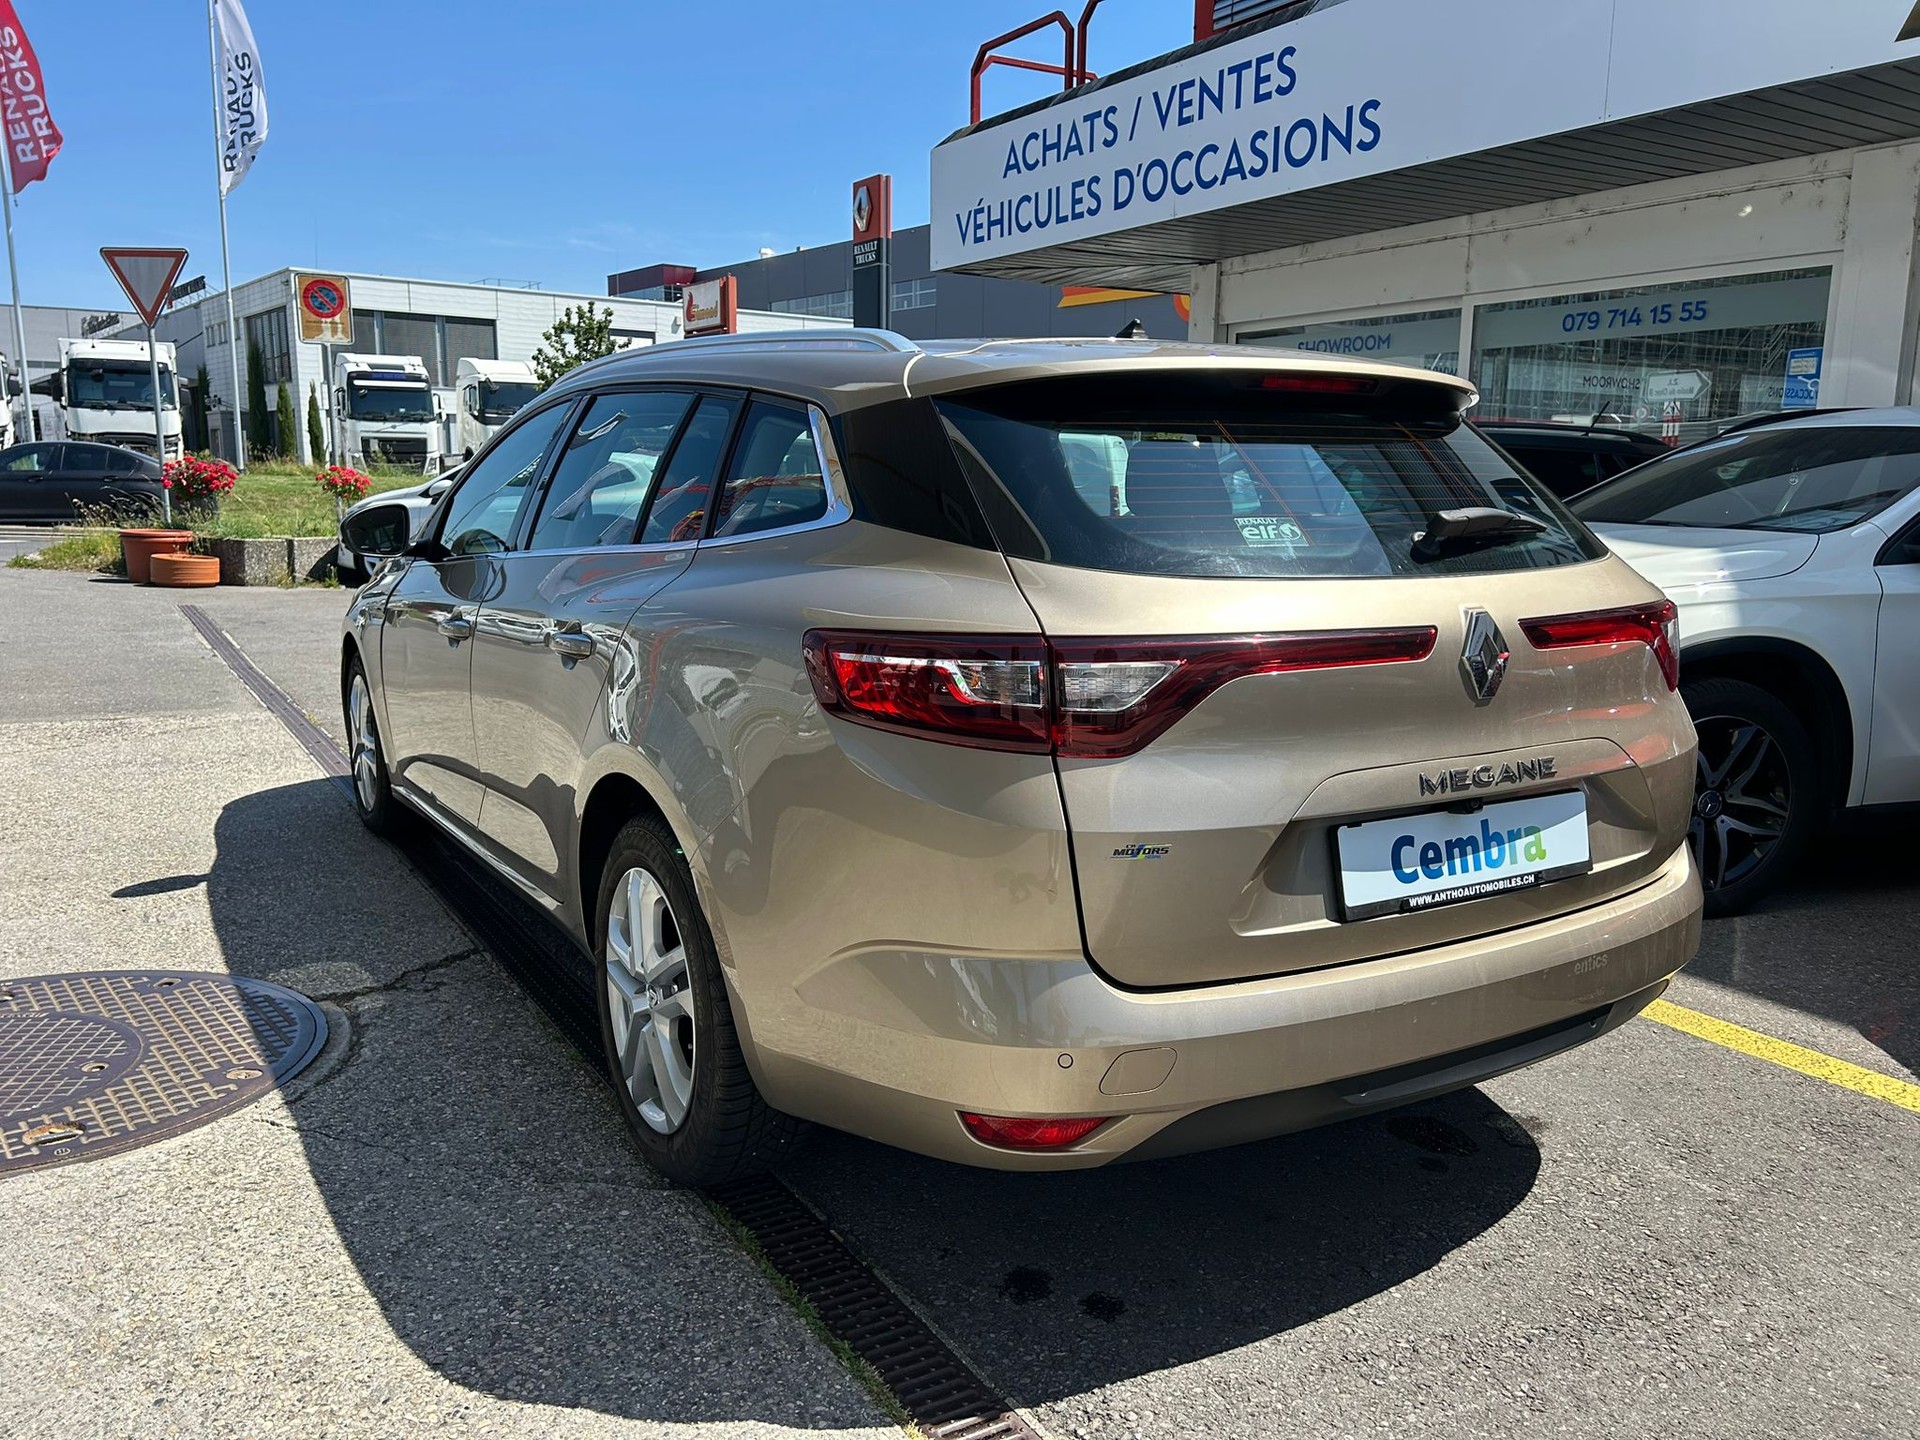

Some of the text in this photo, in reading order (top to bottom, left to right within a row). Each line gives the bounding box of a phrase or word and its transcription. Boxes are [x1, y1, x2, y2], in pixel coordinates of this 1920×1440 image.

[3, 26, 58, 158] TRUCKS
[1002, 46, 1297, 179] ACHATS / VENTES
[955, 98, 1382, 246] VÉHICULES D'OCCASIONS
[853, 241, 878, 255] RENAULT
[855, 252, 876, 265] TRUCKS
[1562, 301, 1707, 332] 079 714 15 55
[1238, 518, 1278, 526] RENAULT
[1242, 525, 1279, 539] elf
[1419, 757, 1558, 797] MEGANE
[1112, 846, 1170, 857] MOTORS
[1390, 818, 1547, 884] Cembra
[1409, 874, 1536, 907] WWW.ANTHOAUTOMOBILES.CH
